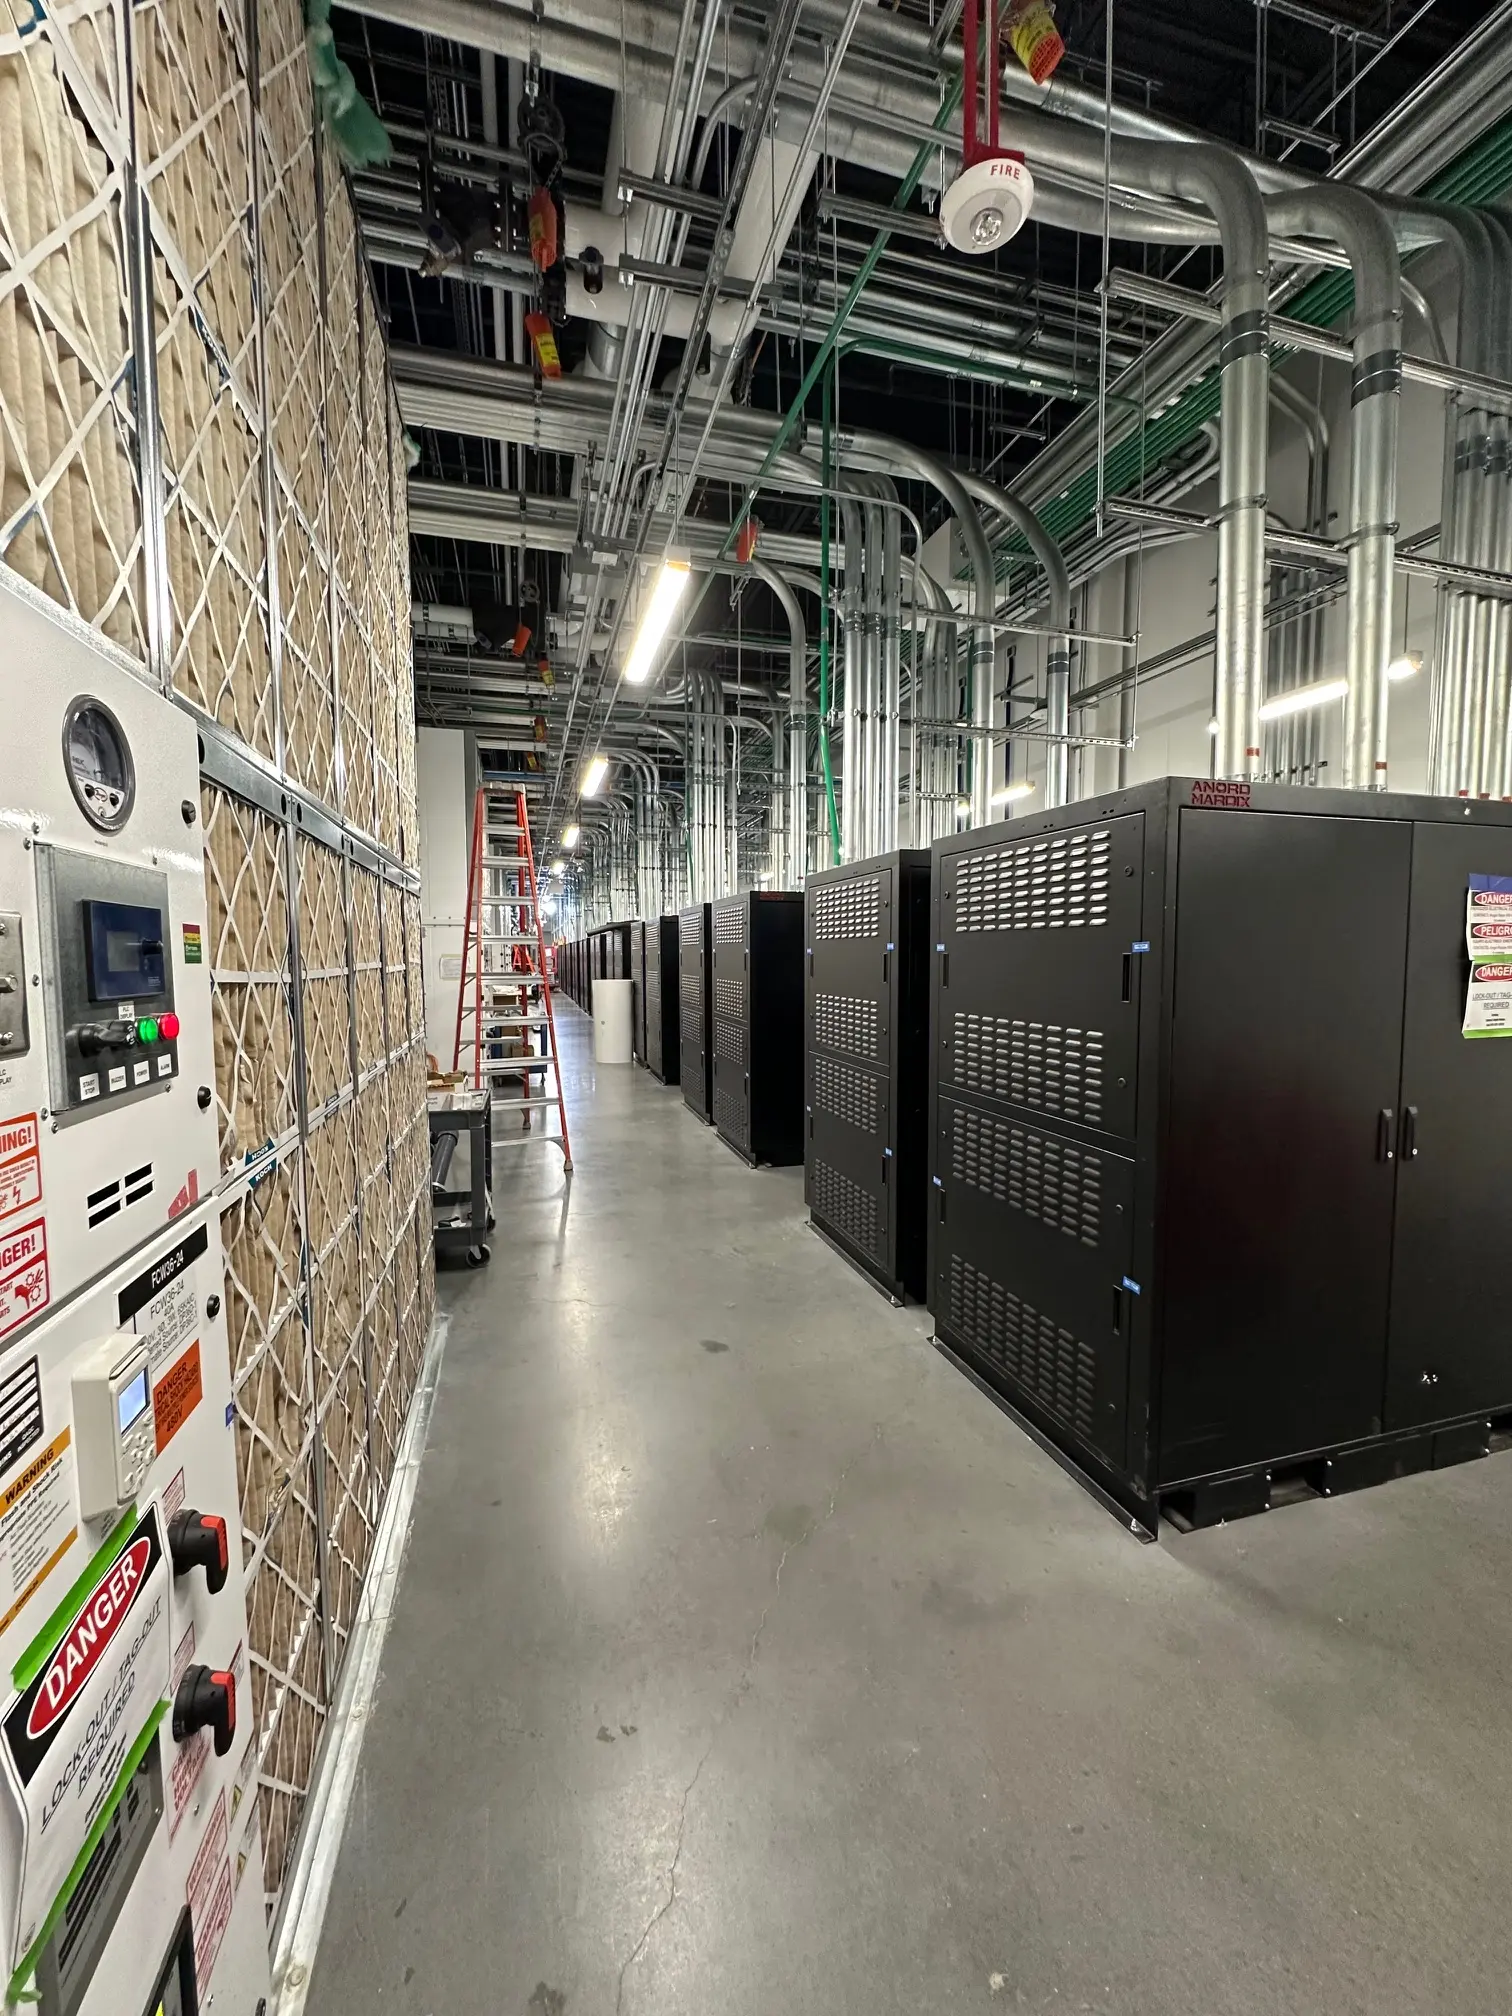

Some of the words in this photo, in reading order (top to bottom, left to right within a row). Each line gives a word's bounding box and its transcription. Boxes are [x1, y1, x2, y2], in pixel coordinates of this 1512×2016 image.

[990, 164, 1021, 180] FIRE
[1191, 793, 1251, 808] MARDIX
[1192, 780, 1251, 796] ANORD
[0, 1077, 12, 1085] PLAY
[0, 1126, 32, 1154] ING!
[251, 1145, 269, 1160] KOCH
[255, 1164, 273, 1182] KOCH
[0, 1234, 36, 1268] GER!
[151, 1249, 184, 1289] FCW36-24
[0, 1281, 14, 1296] TART
[150, 1279, 185, 1320] FCW36-24
[156, 1361, 188, 1406] DANGER
[5, 1448, 55, 1505] WARNING
[1, 1505, 19, 1528] Flash
[20, 1490, 31, 1507] and
[32, 1471, 50, 1494] Shock
[45, 1554, 139, 1711] DANGER
[42, 1687, 111, 1828] LOCK-OUT
[119, 1596, 162, 1681] TAG-OUT
[78, 1670, 136, 1793] REQUIRED
